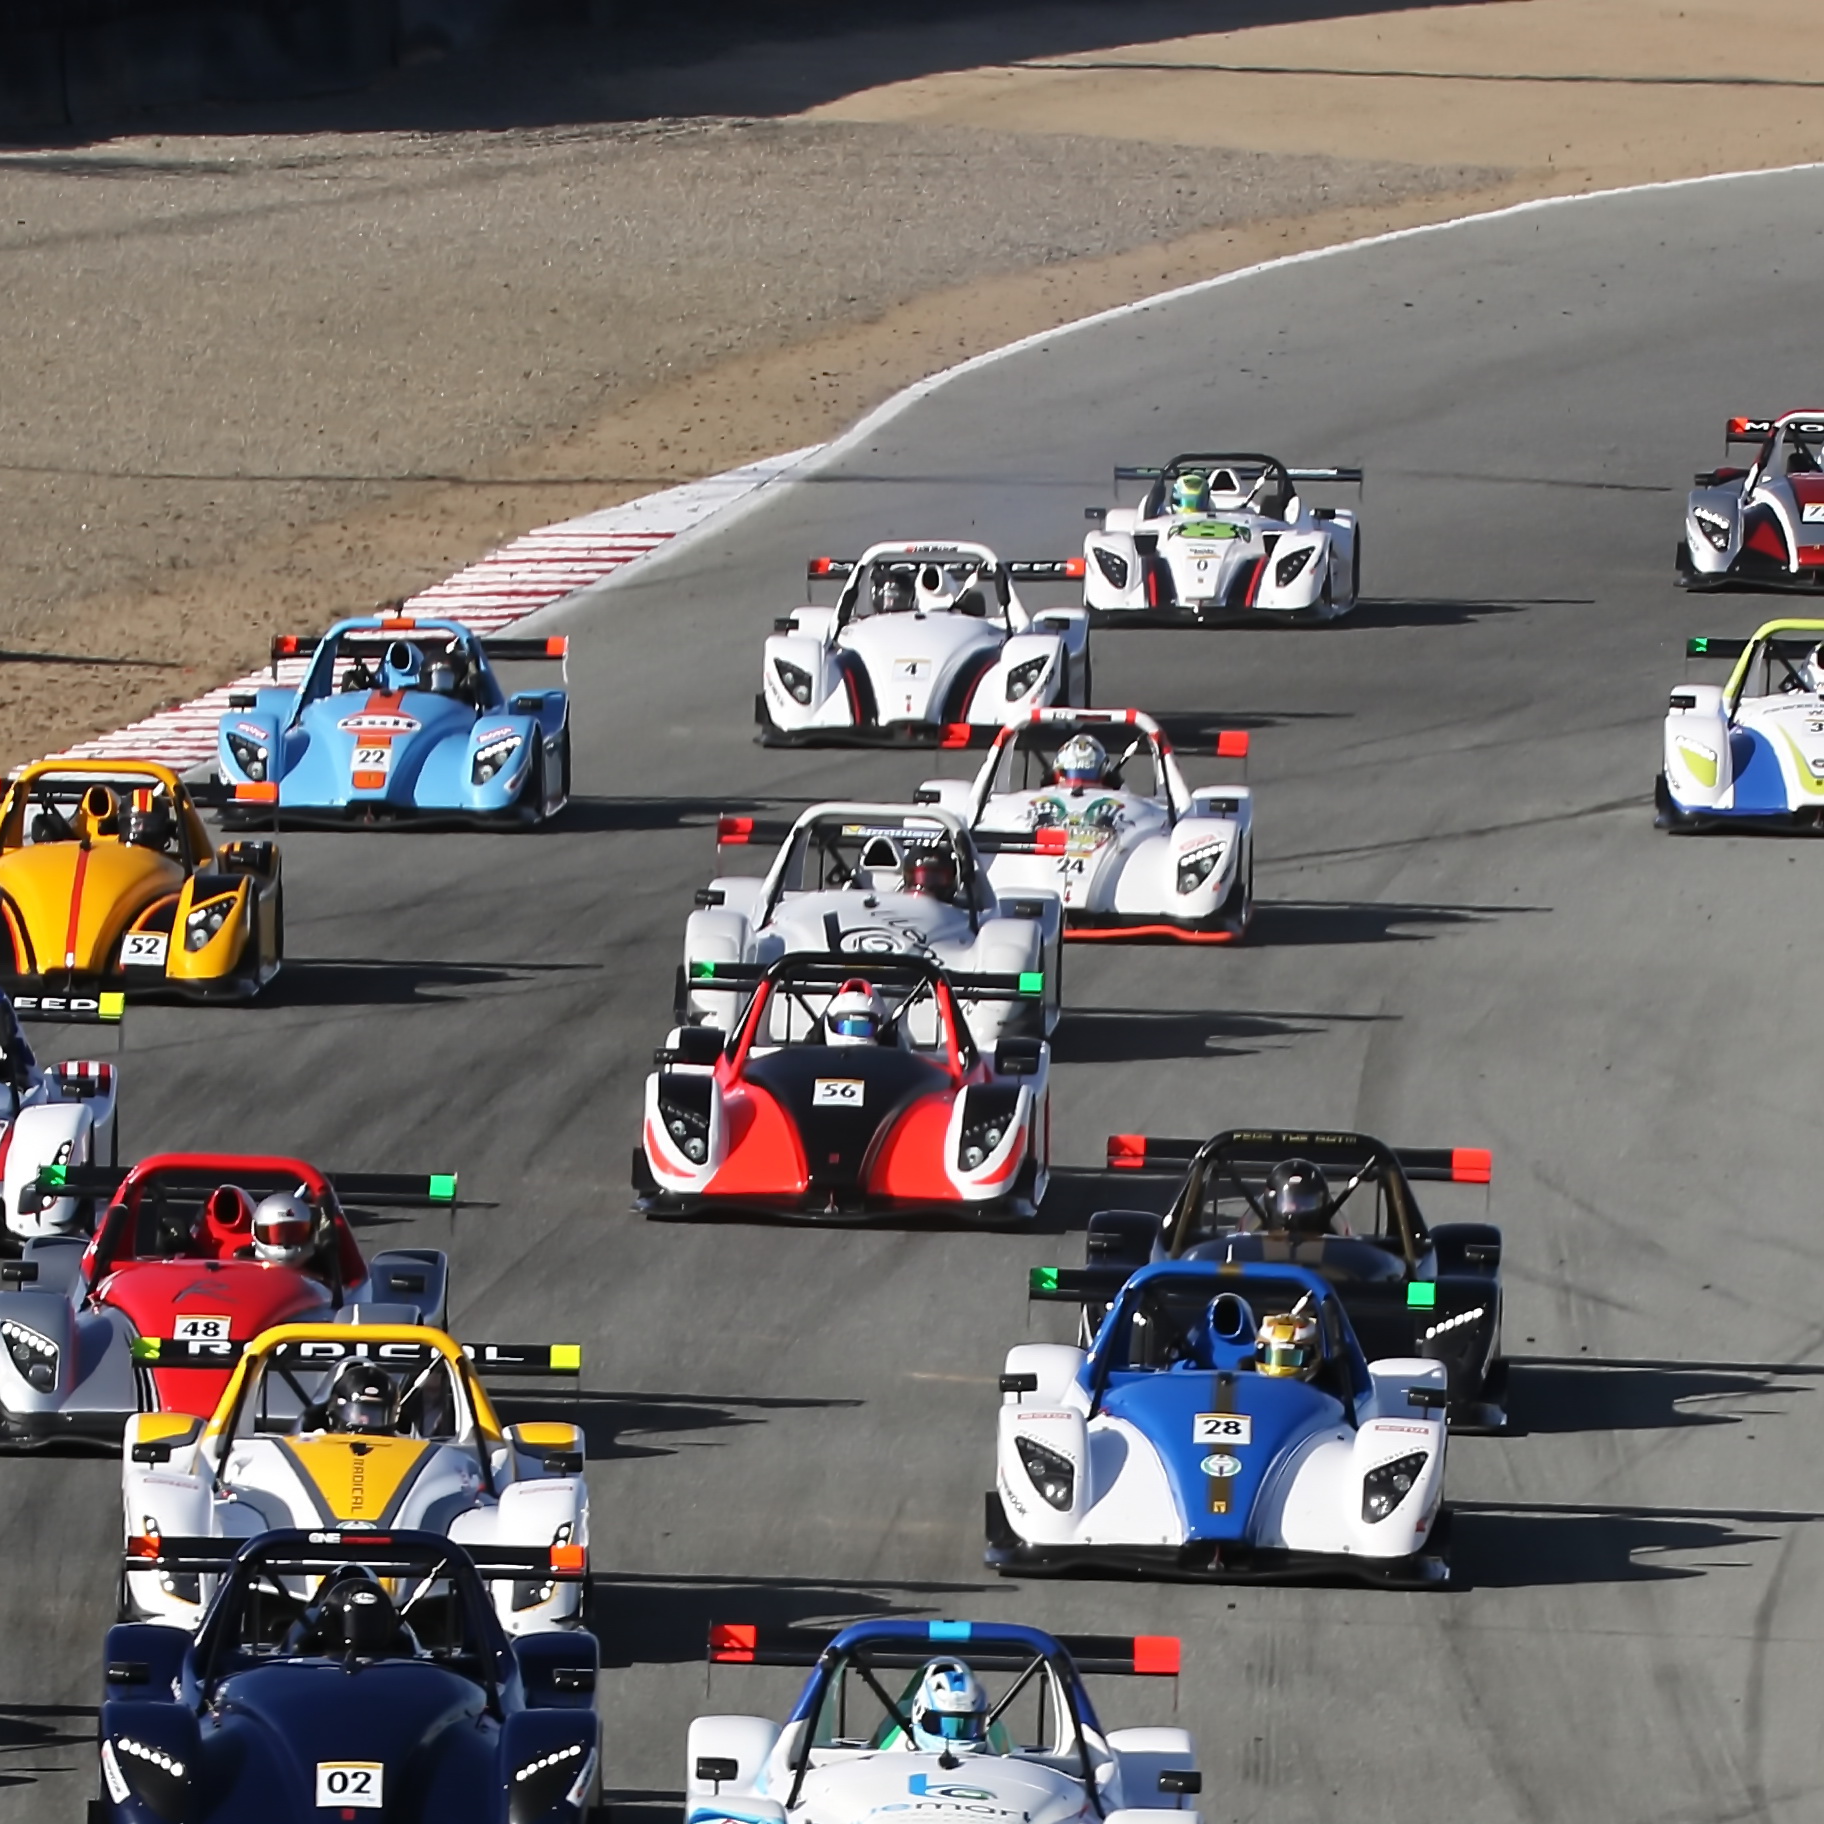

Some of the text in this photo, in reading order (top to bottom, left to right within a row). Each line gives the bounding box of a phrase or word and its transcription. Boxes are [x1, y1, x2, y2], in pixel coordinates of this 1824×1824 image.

[358, 750, 385, 764] 22
[1057, 857, 1084, 873] 24
[128, 937, 161, 955] 52
[822, 1083, 857, 1098] 56
[182, 1321, 220, 1338] 48
[188, 1340, 524, 1361] RDICL
[1204, 1419, 1242, 1436] 28
[351, 1457, 365, 1514] RADICAL
[326, 1770, 373, 1794] 02
